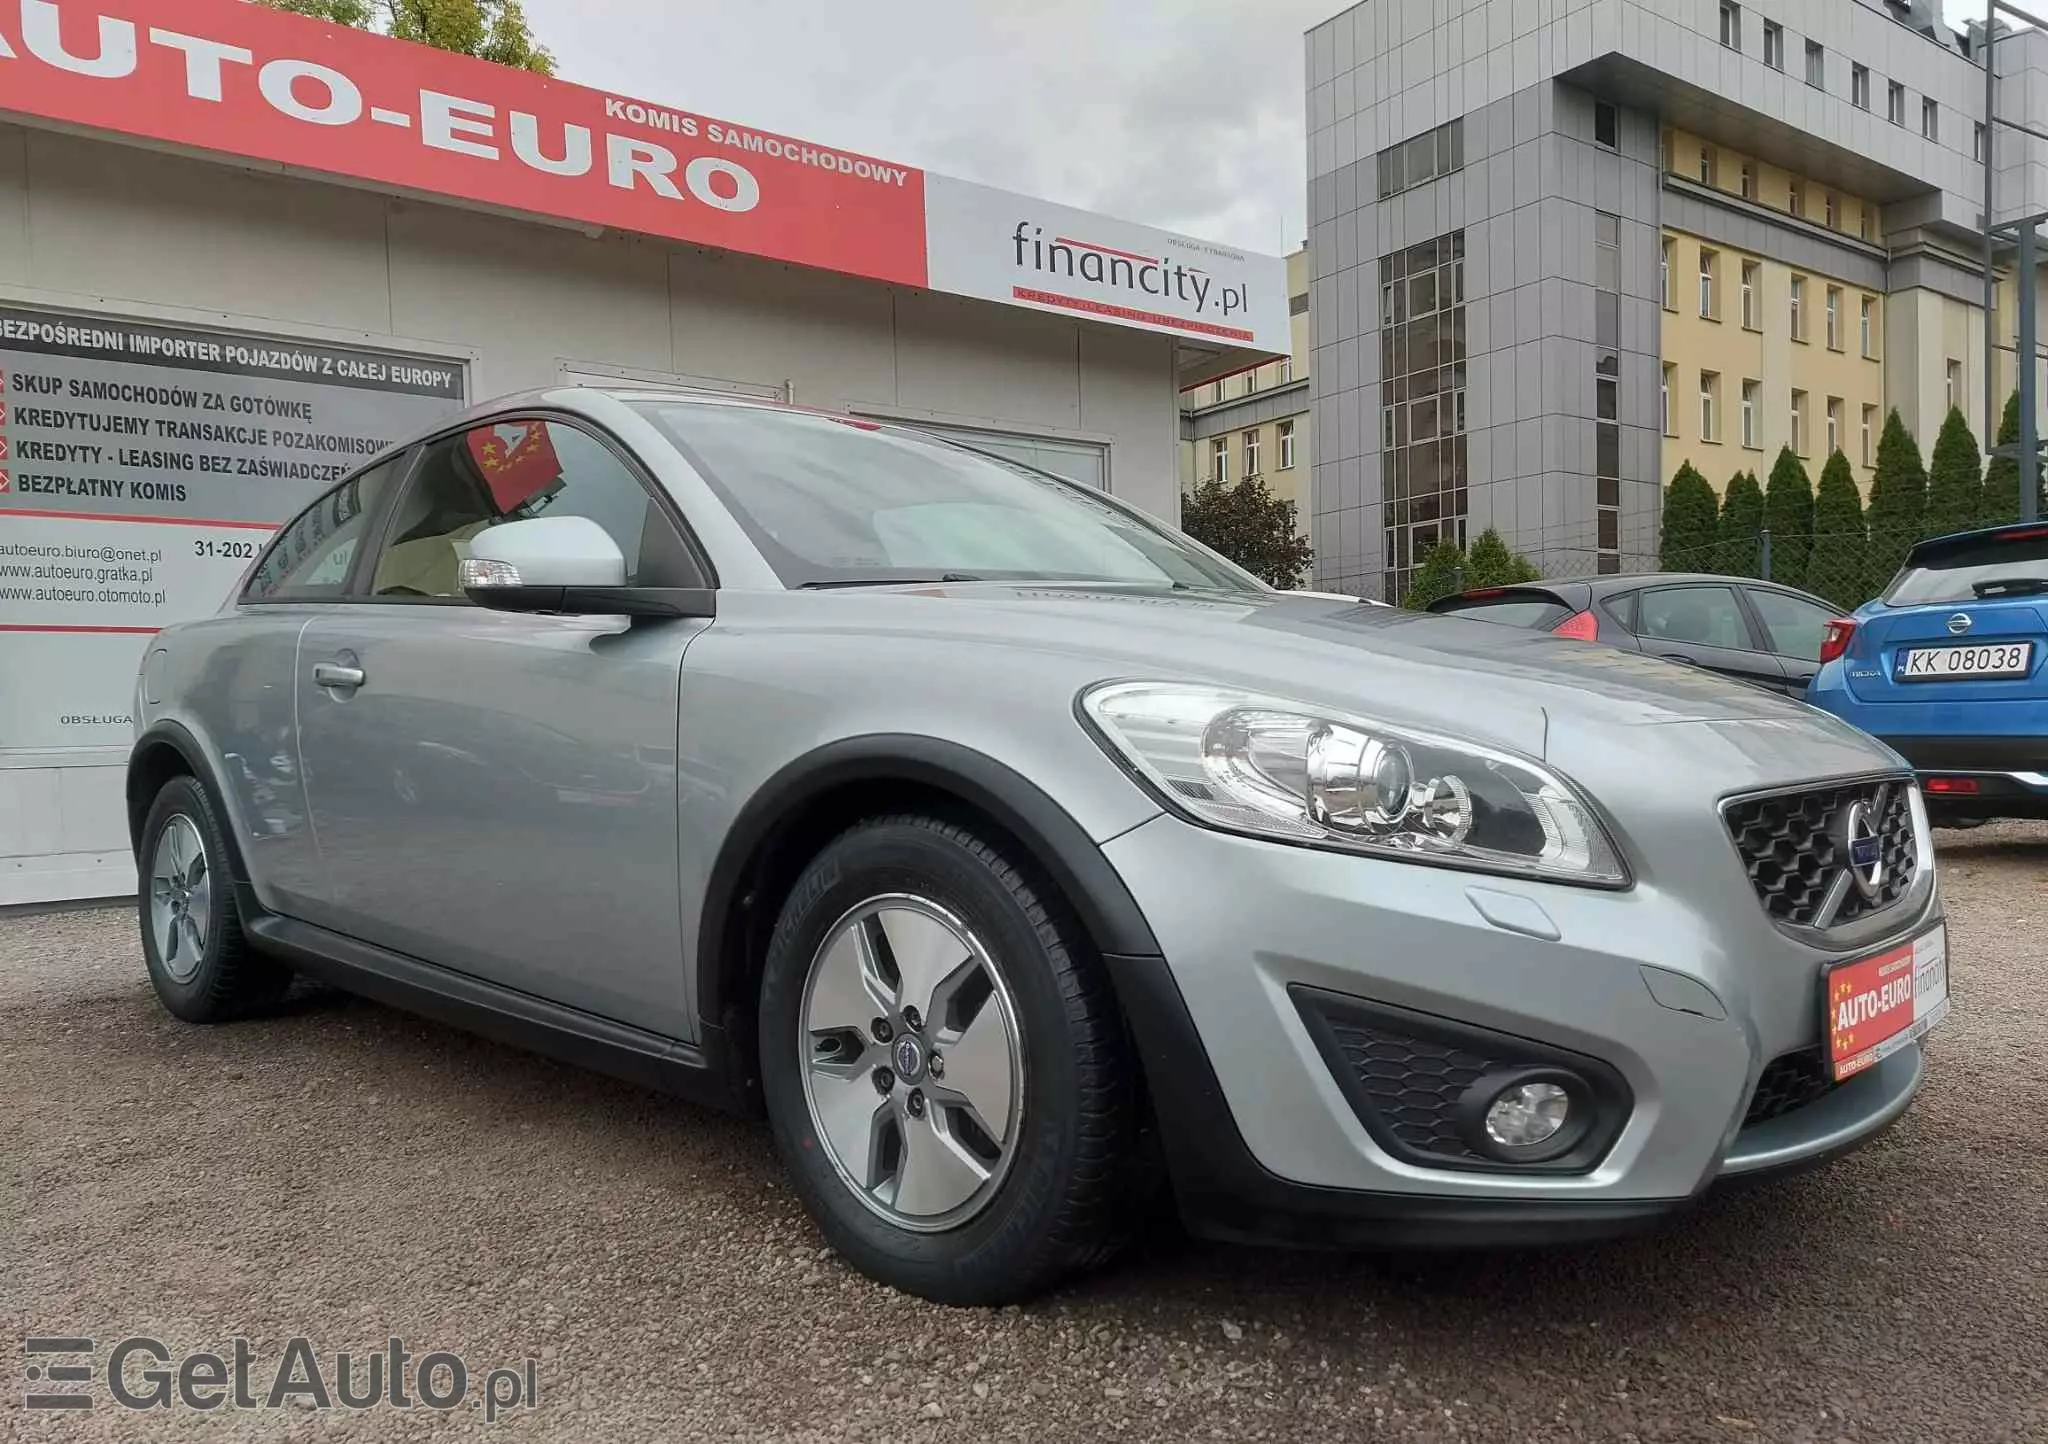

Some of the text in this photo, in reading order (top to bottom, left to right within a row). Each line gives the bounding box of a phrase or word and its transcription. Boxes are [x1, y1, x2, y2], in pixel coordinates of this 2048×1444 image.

[0, 0, 760, 212] UTO-EURO
[605, 97, 907, 187] KOMIS SAMOCHODOWY
[1012, 221, 1248, 316] financity.pl
[129, 334, 221, 363] IMPORTER
[226, 346, 320, 374] POJAZDÓW
[321, 357, 334, 375] Z
[337, 360, 387, 382] CAŁEJ
[391, 365, 453, 389] EUROPY
[12, 373, 313, 424] SKUP SAMOCHODÓW ZA GOTÓWKĘ
[14, 406, 397, 456] KREDYTUJEMY TRANSAKCJE POZAKOMISOW
[16, 440, 102, 464] KREDYTY
[119, 448, 194, 471] LEASING
[200, 455, 232, 473] BEZ
[18, 474, 186, 502] BEZPŁATNY KOMIS
[194, 541, 253, 559] 31-202
[1910, 648, 2022, 673] KK 08038
[1837, 974, 1912, 1032] AUTO-EURO
